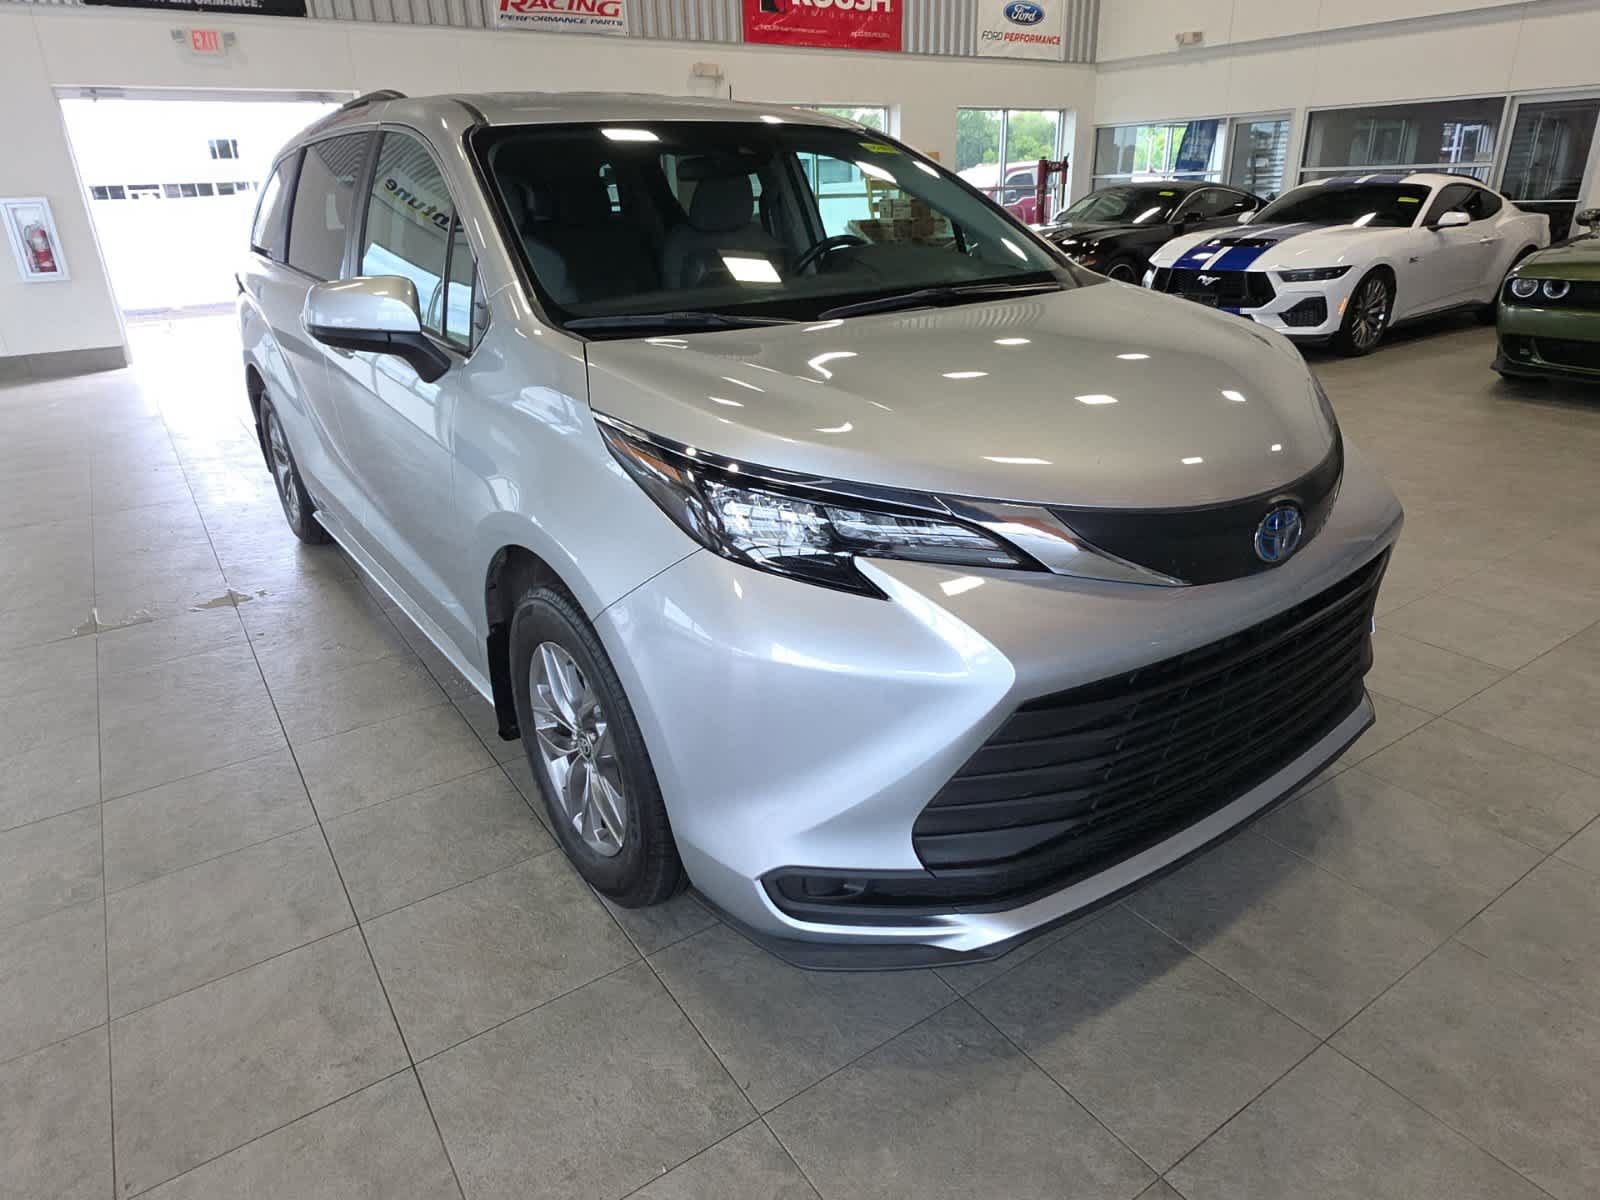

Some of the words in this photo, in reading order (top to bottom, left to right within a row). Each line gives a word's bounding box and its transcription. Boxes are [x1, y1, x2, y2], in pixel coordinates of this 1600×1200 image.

[500, 14, 586, 24] PERFORMANCE
[590, 18, 623, 26] PARTS
[1011, 3, 1037, 22] Ford
[191, 30, 218, 51] EXIT
[981, 30, 1003, 41] FORD
[1003, 31, 1061, 46] PERFORMANCE
